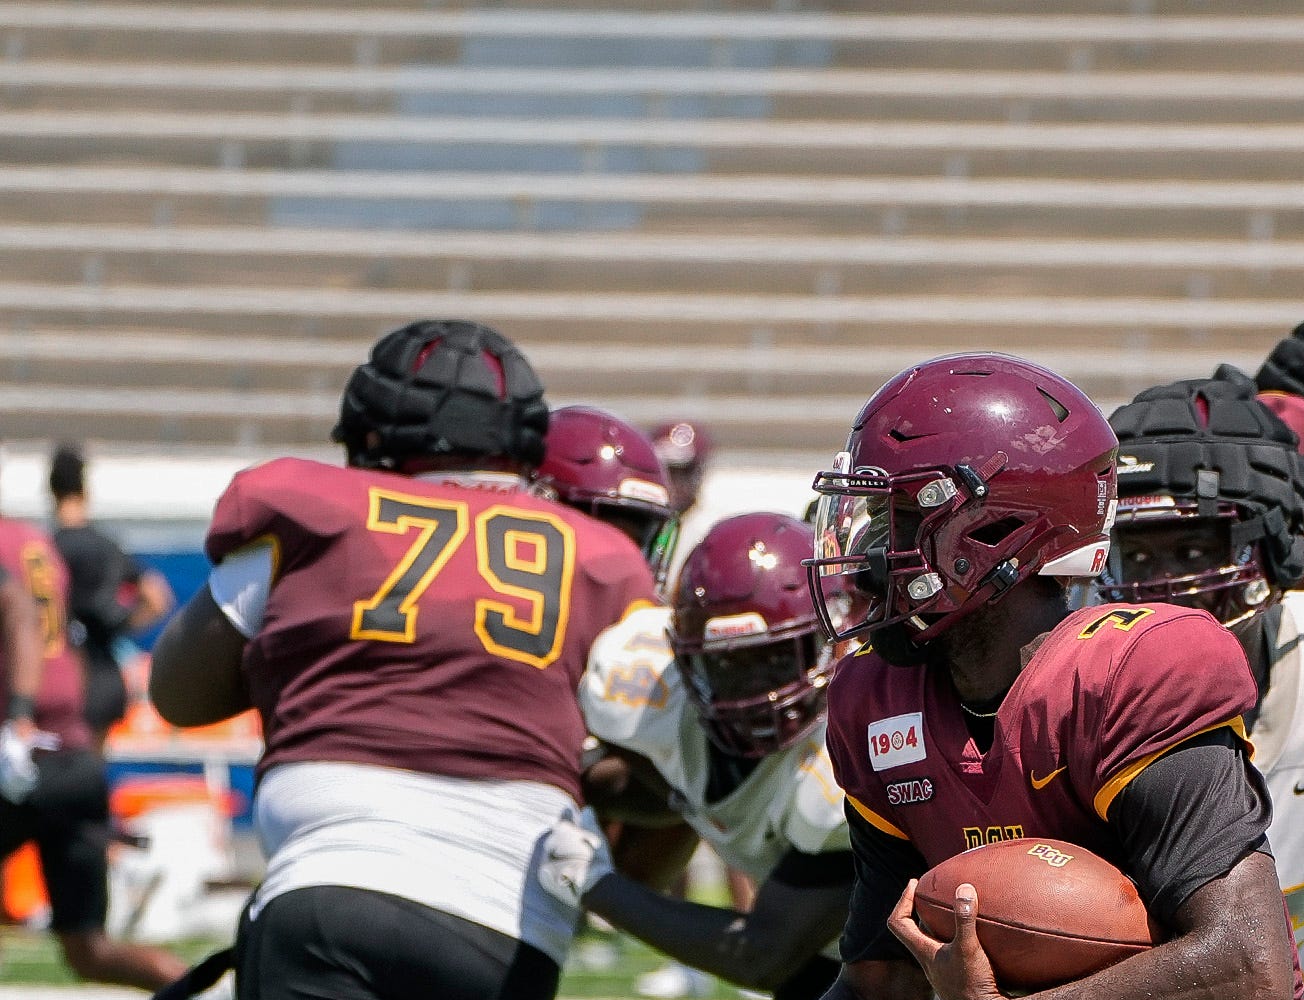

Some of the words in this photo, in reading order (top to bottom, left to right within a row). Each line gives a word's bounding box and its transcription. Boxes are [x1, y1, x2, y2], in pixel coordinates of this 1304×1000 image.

[351, 486, 576, 669] 79
[1077, 607, 1155, 640] 7
[870, 725, 918, 757] 1904
[886, 778, 933, 805] SWAC
[1028, 843, 1074, 868] BCU
